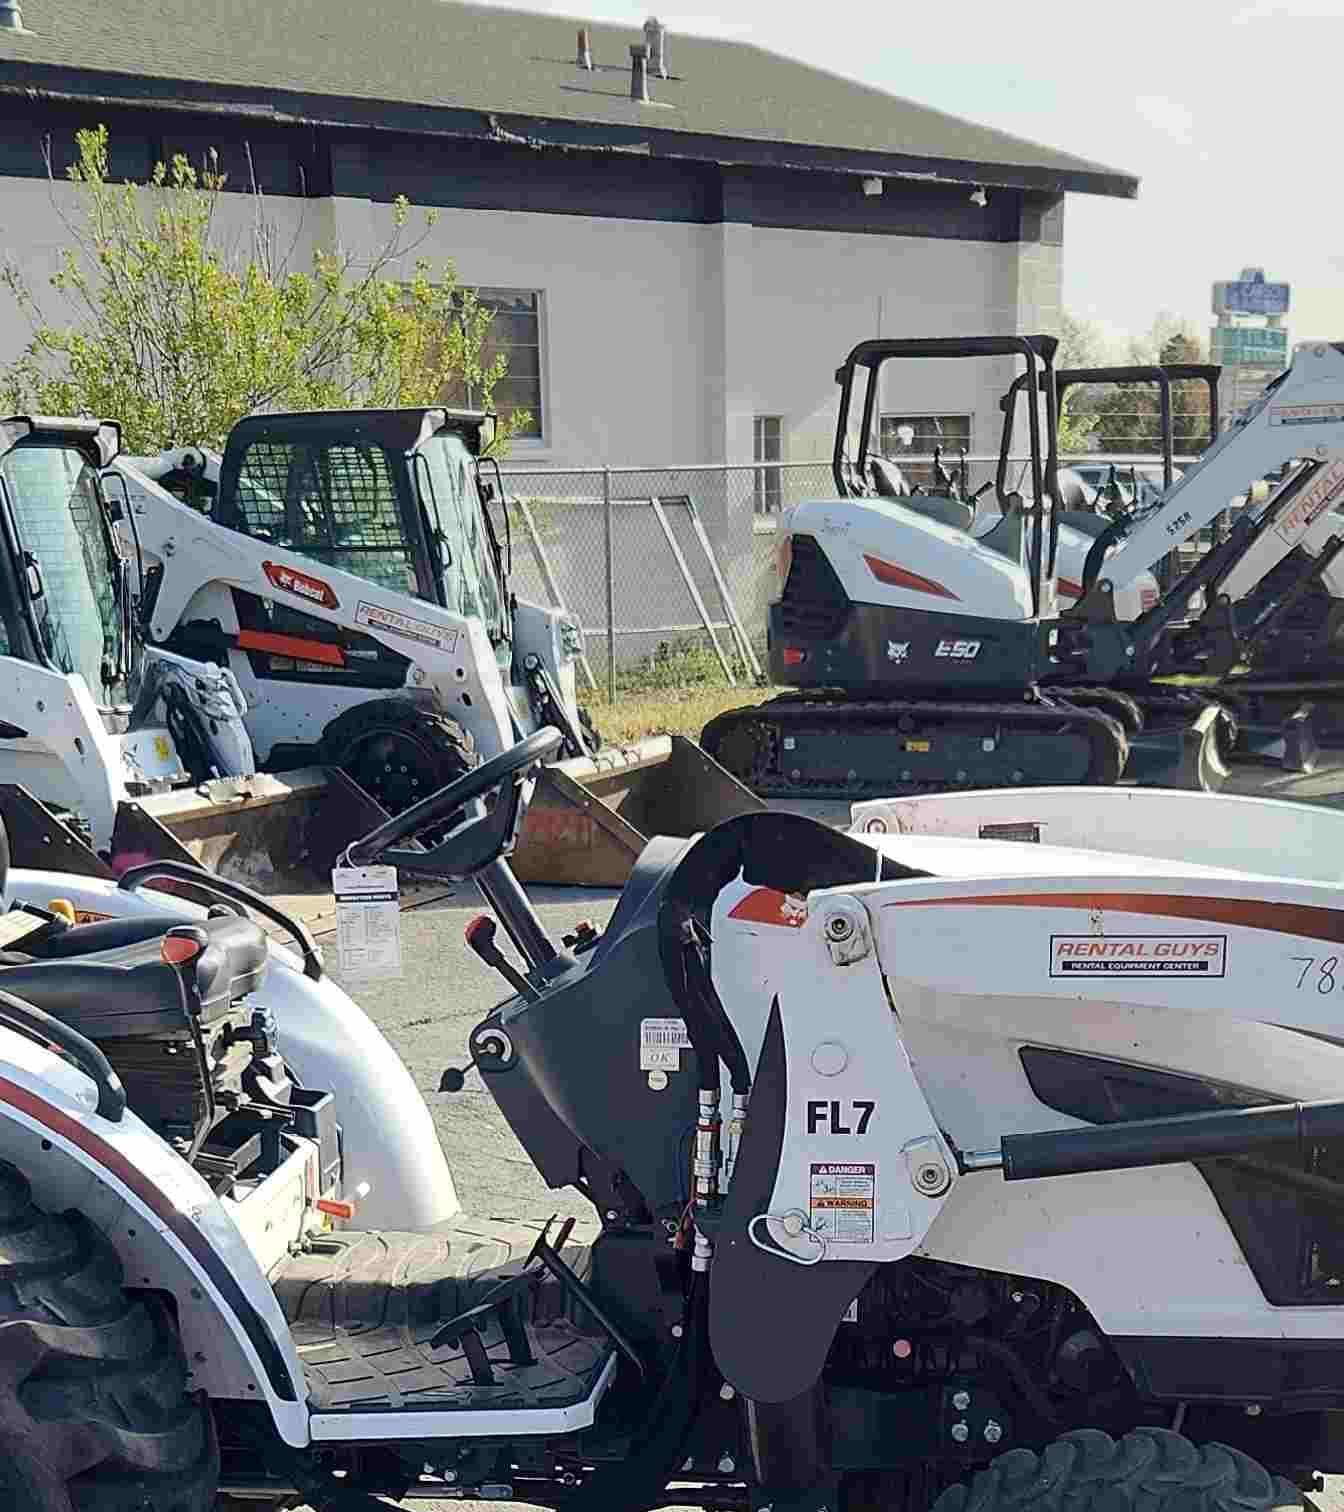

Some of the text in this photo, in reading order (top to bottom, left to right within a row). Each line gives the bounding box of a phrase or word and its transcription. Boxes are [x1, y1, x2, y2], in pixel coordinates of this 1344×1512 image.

[935, 640, 981, 658] E50
[1056, 943, 1220, 957] RENTAL GUYS
[1071, 962, 1200, 970] RENTAL EQUIPMENT CENTER
[807, 1101, 875, 1134] FL7
[828, 1165, 866, 1174] DANGER
[826, 1199, 869, 1208] WARNING
